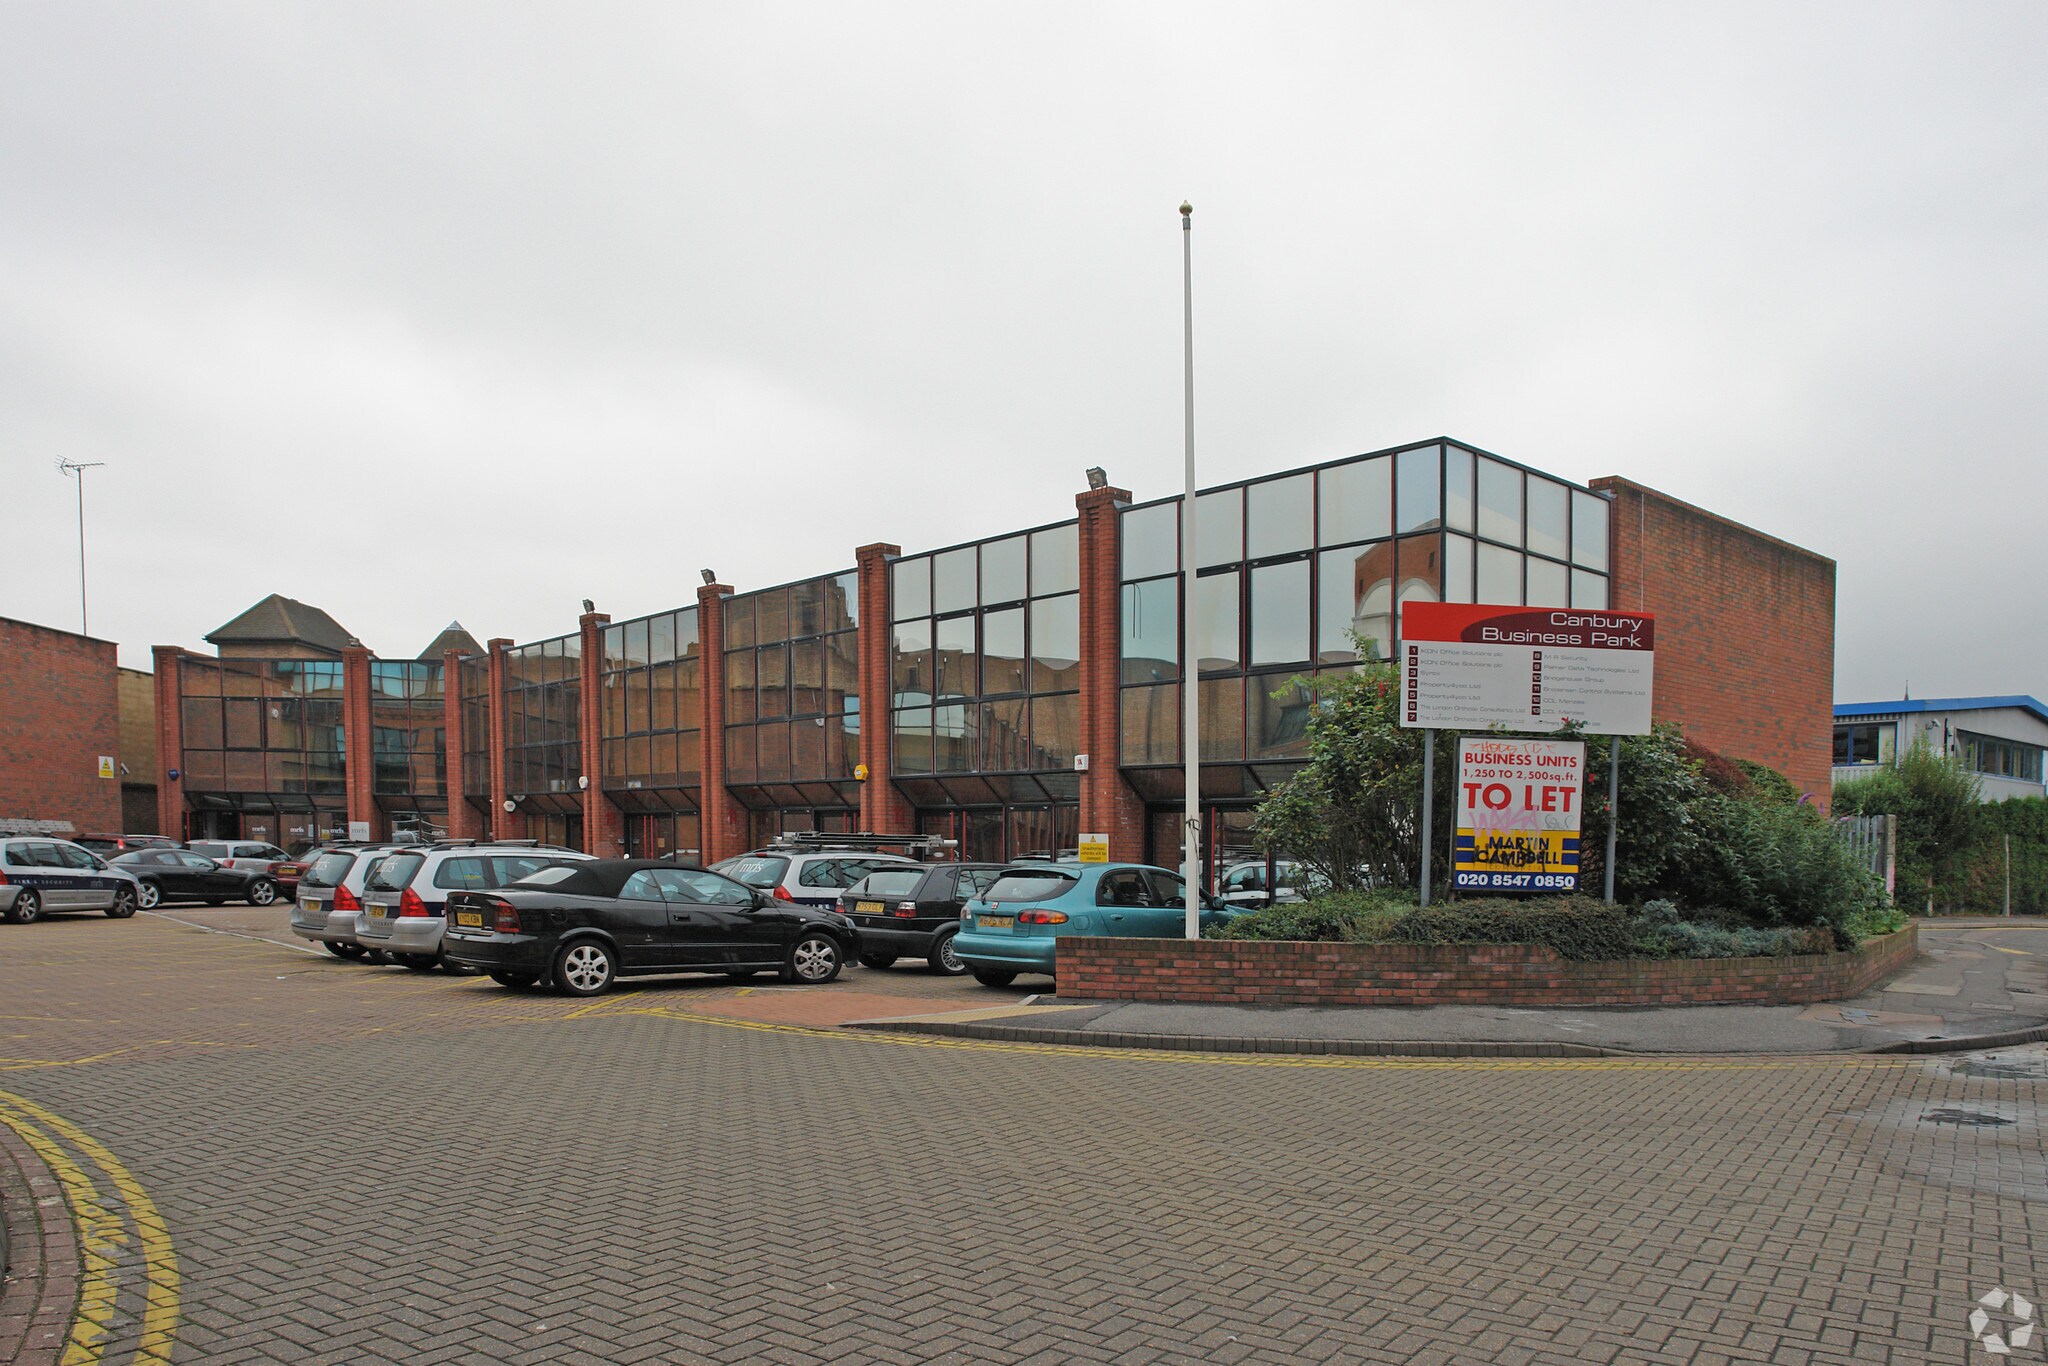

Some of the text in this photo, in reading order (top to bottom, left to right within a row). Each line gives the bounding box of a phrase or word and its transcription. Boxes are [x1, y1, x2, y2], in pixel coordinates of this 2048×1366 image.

[1550, 612, 1643, 632] Canbury
[1482, 626, 1642, 648] Business Park
[1465, 752, 1577, 768] BUSINESS UNITS
[1463, 768, 1495, 778] 1,250
[1498, 770, 1513, 778] TO
[1463, 782, 1577, 812] TO LET
[1489, 836, 1550, 850] MARTIN
[1458, 874, 1575, 888] 020 8547 0850
